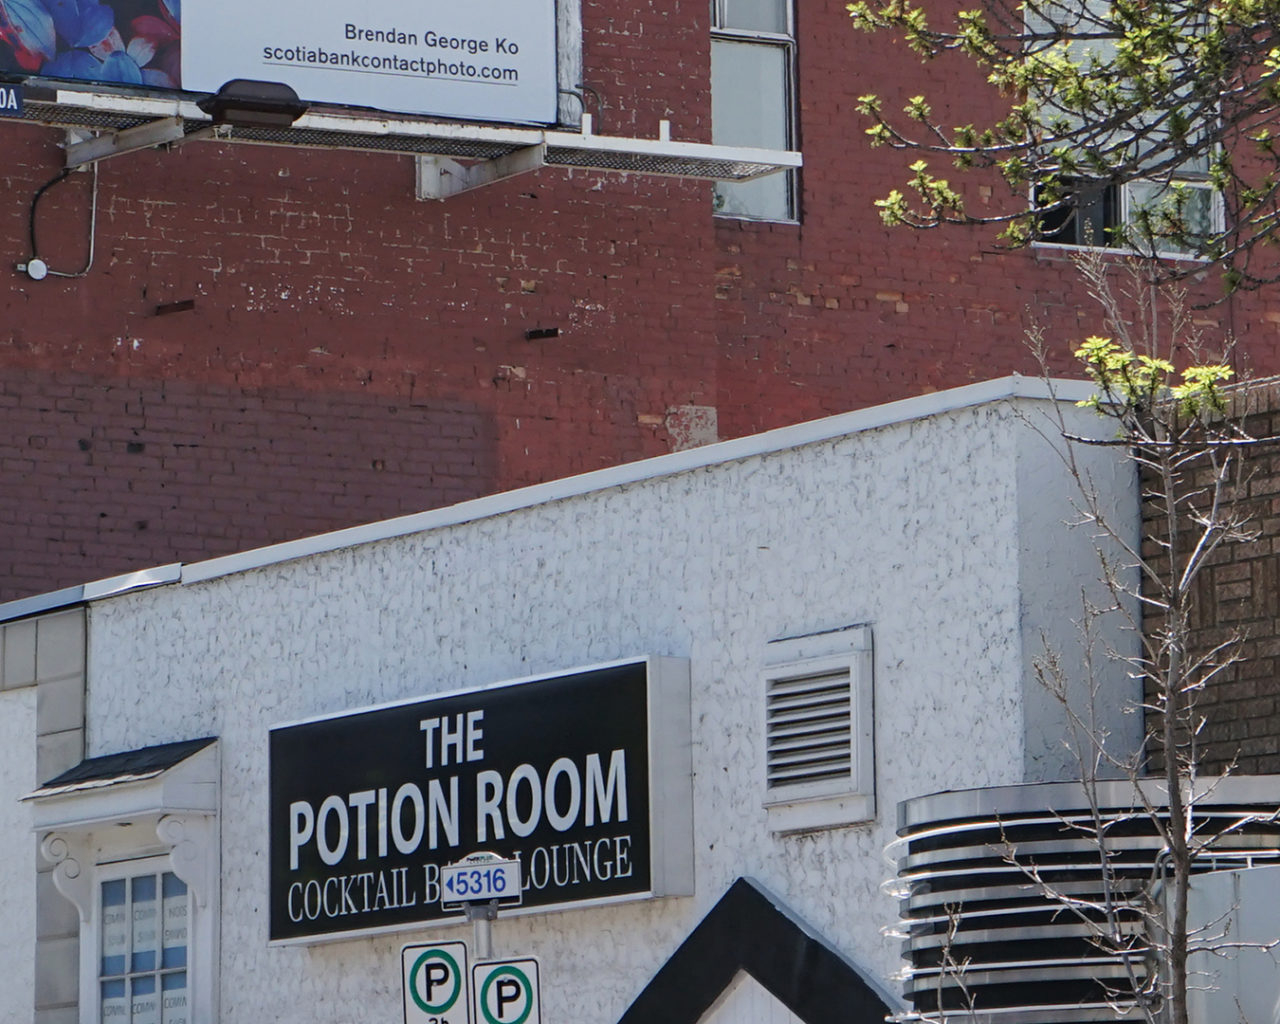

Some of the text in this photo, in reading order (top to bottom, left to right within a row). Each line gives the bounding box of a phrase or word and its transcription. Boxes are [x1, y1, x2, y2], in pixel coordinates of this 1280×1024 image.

[344, 24, 519, 55] Brendan George Ko
[262, 45, 519, 80] scotiabankcontactphoto.com
[420, 709, 484, 769] THE
[289, 749, 629, 871] POTION ROOM
[287, 867, 416, 922] COCKTAIL
[456, 867, 507, 896] 5316
[424, 962, 450, 1002] P
[496, 978, 522, 1018] P
